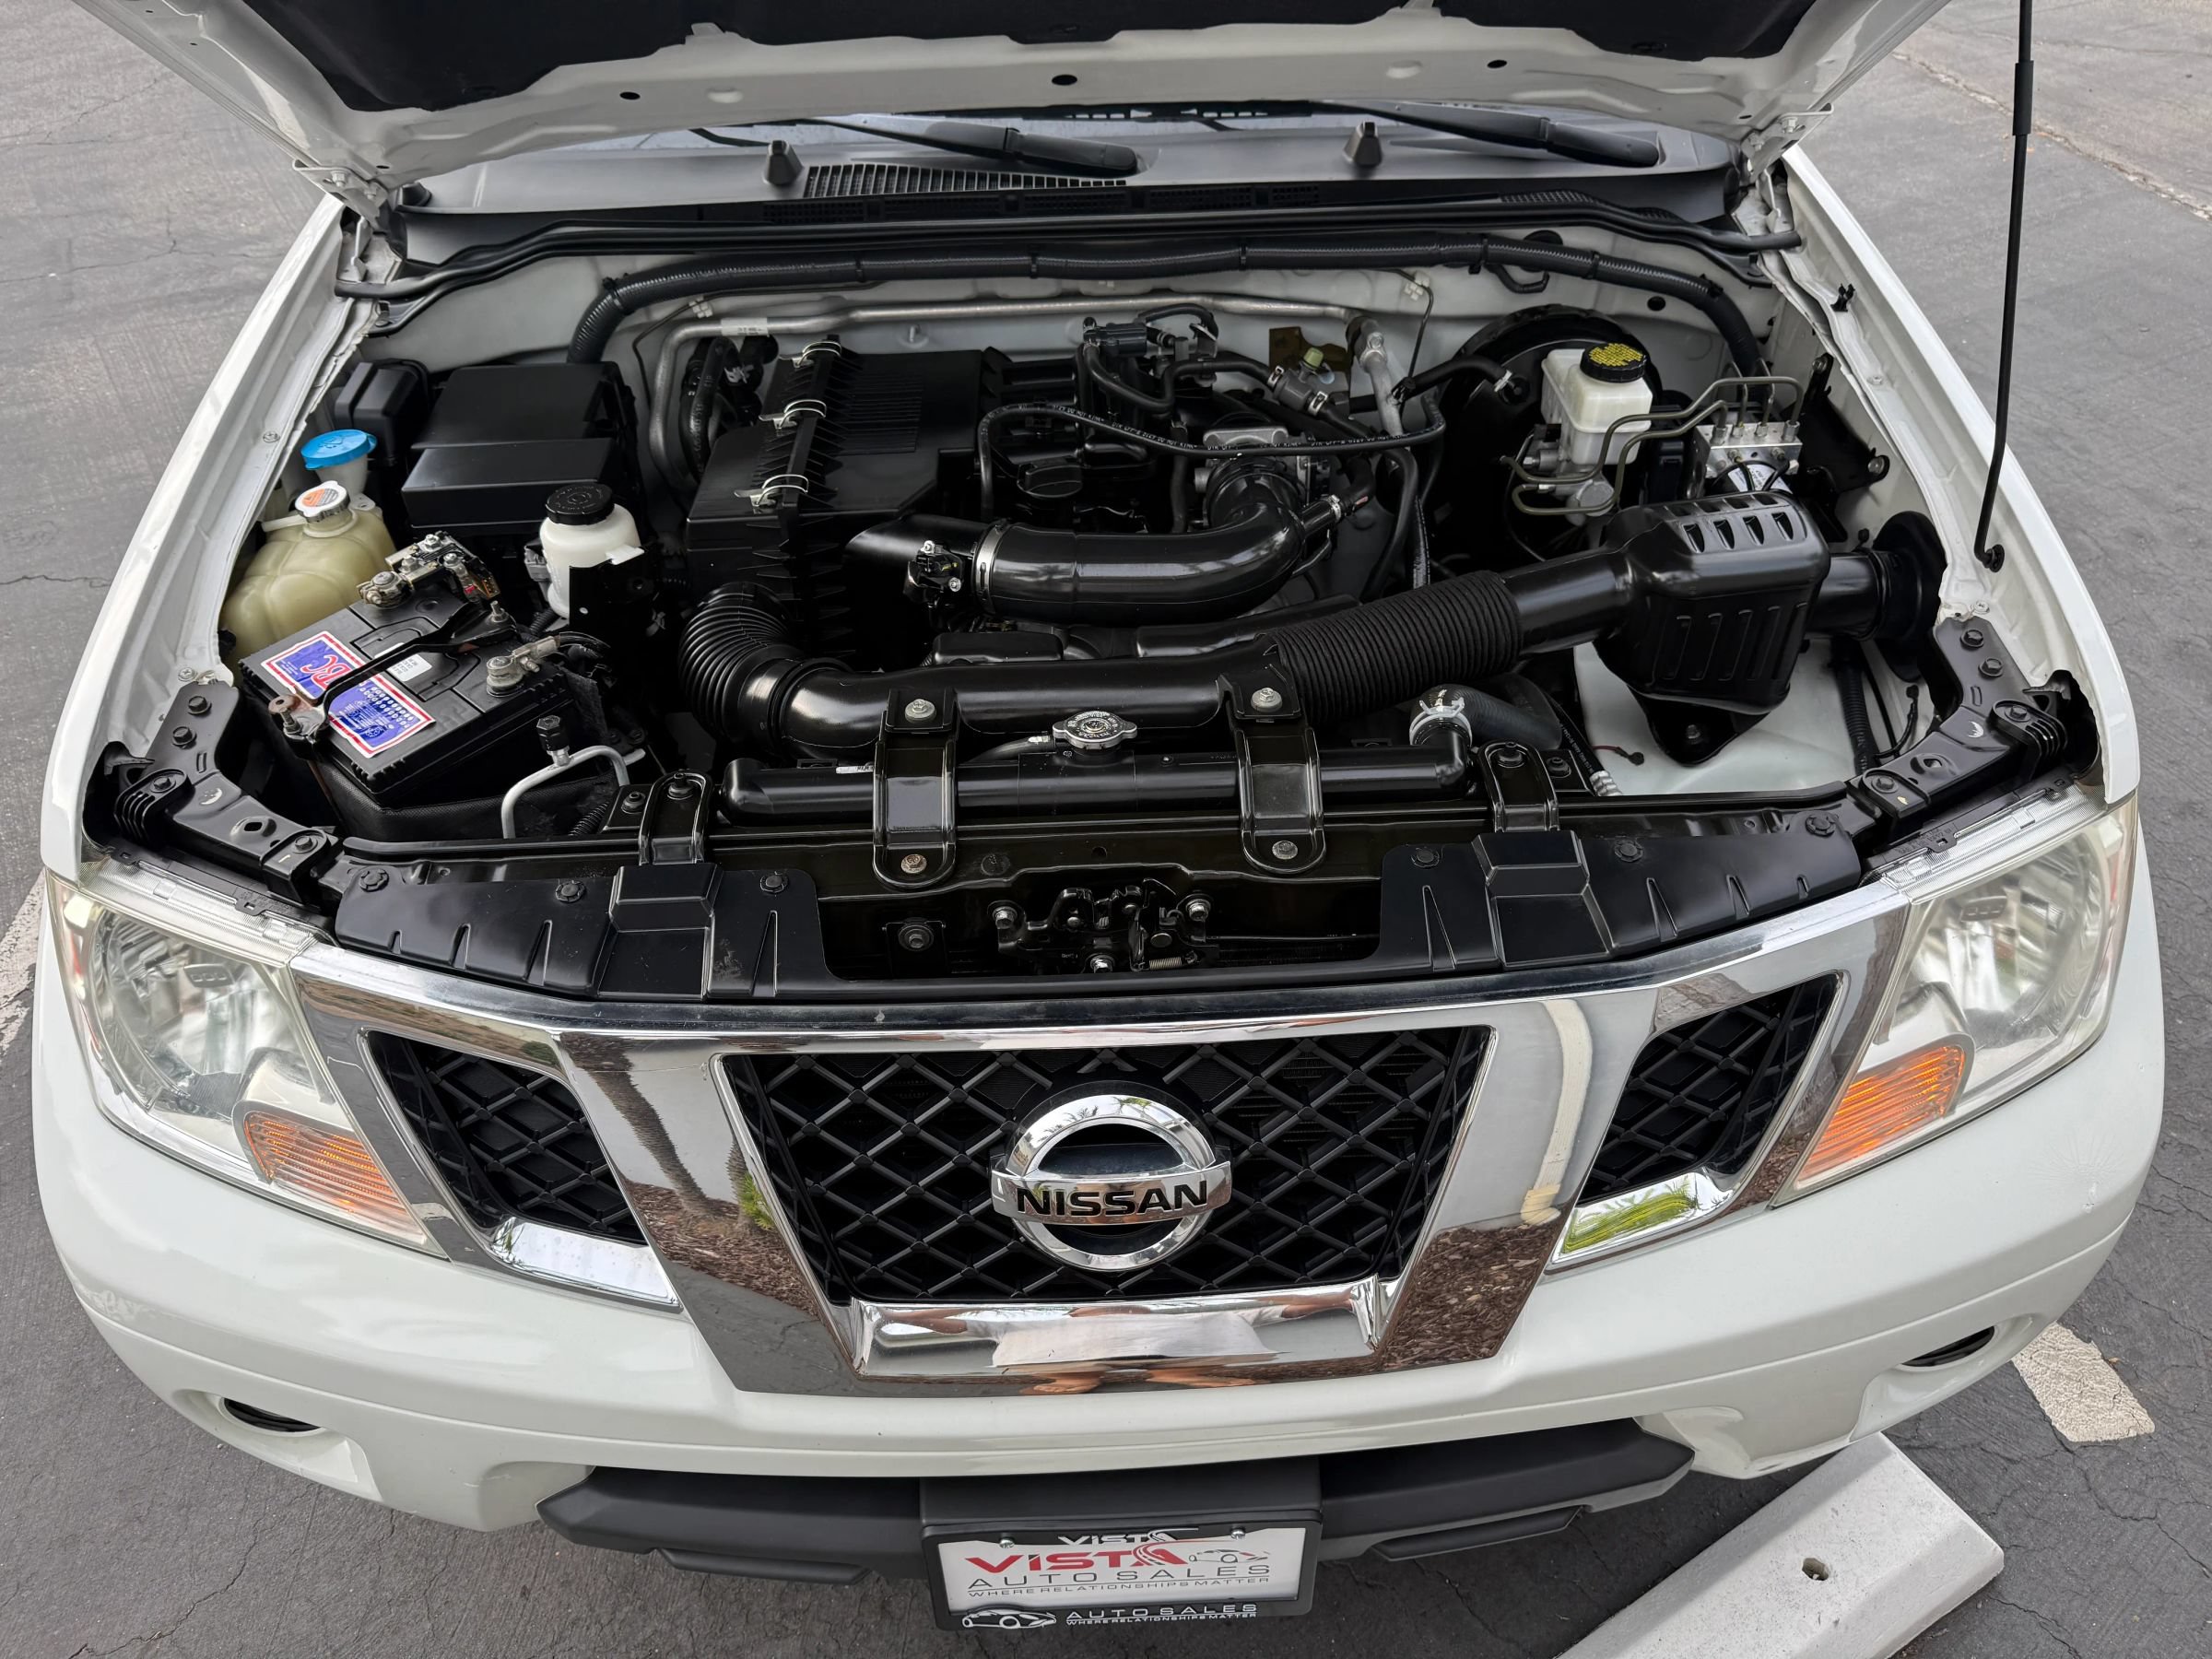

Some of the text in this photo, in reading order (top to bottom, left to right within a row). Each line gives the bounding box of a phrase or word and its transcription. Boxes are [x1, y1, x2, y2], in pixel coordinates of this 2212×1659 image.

[1017, 1180, 1206, 1218] NISSAN
[1058, 1529, 1181, 1546] VISTA
[965, 1543, 1189, 1573] VISTA
[969, 1564, 1270, 1590] AUTO SALES
[1194, 1577, 1269, 1586] MATTER
[1066, 1604, 1257, 1619] AUTO SALES
